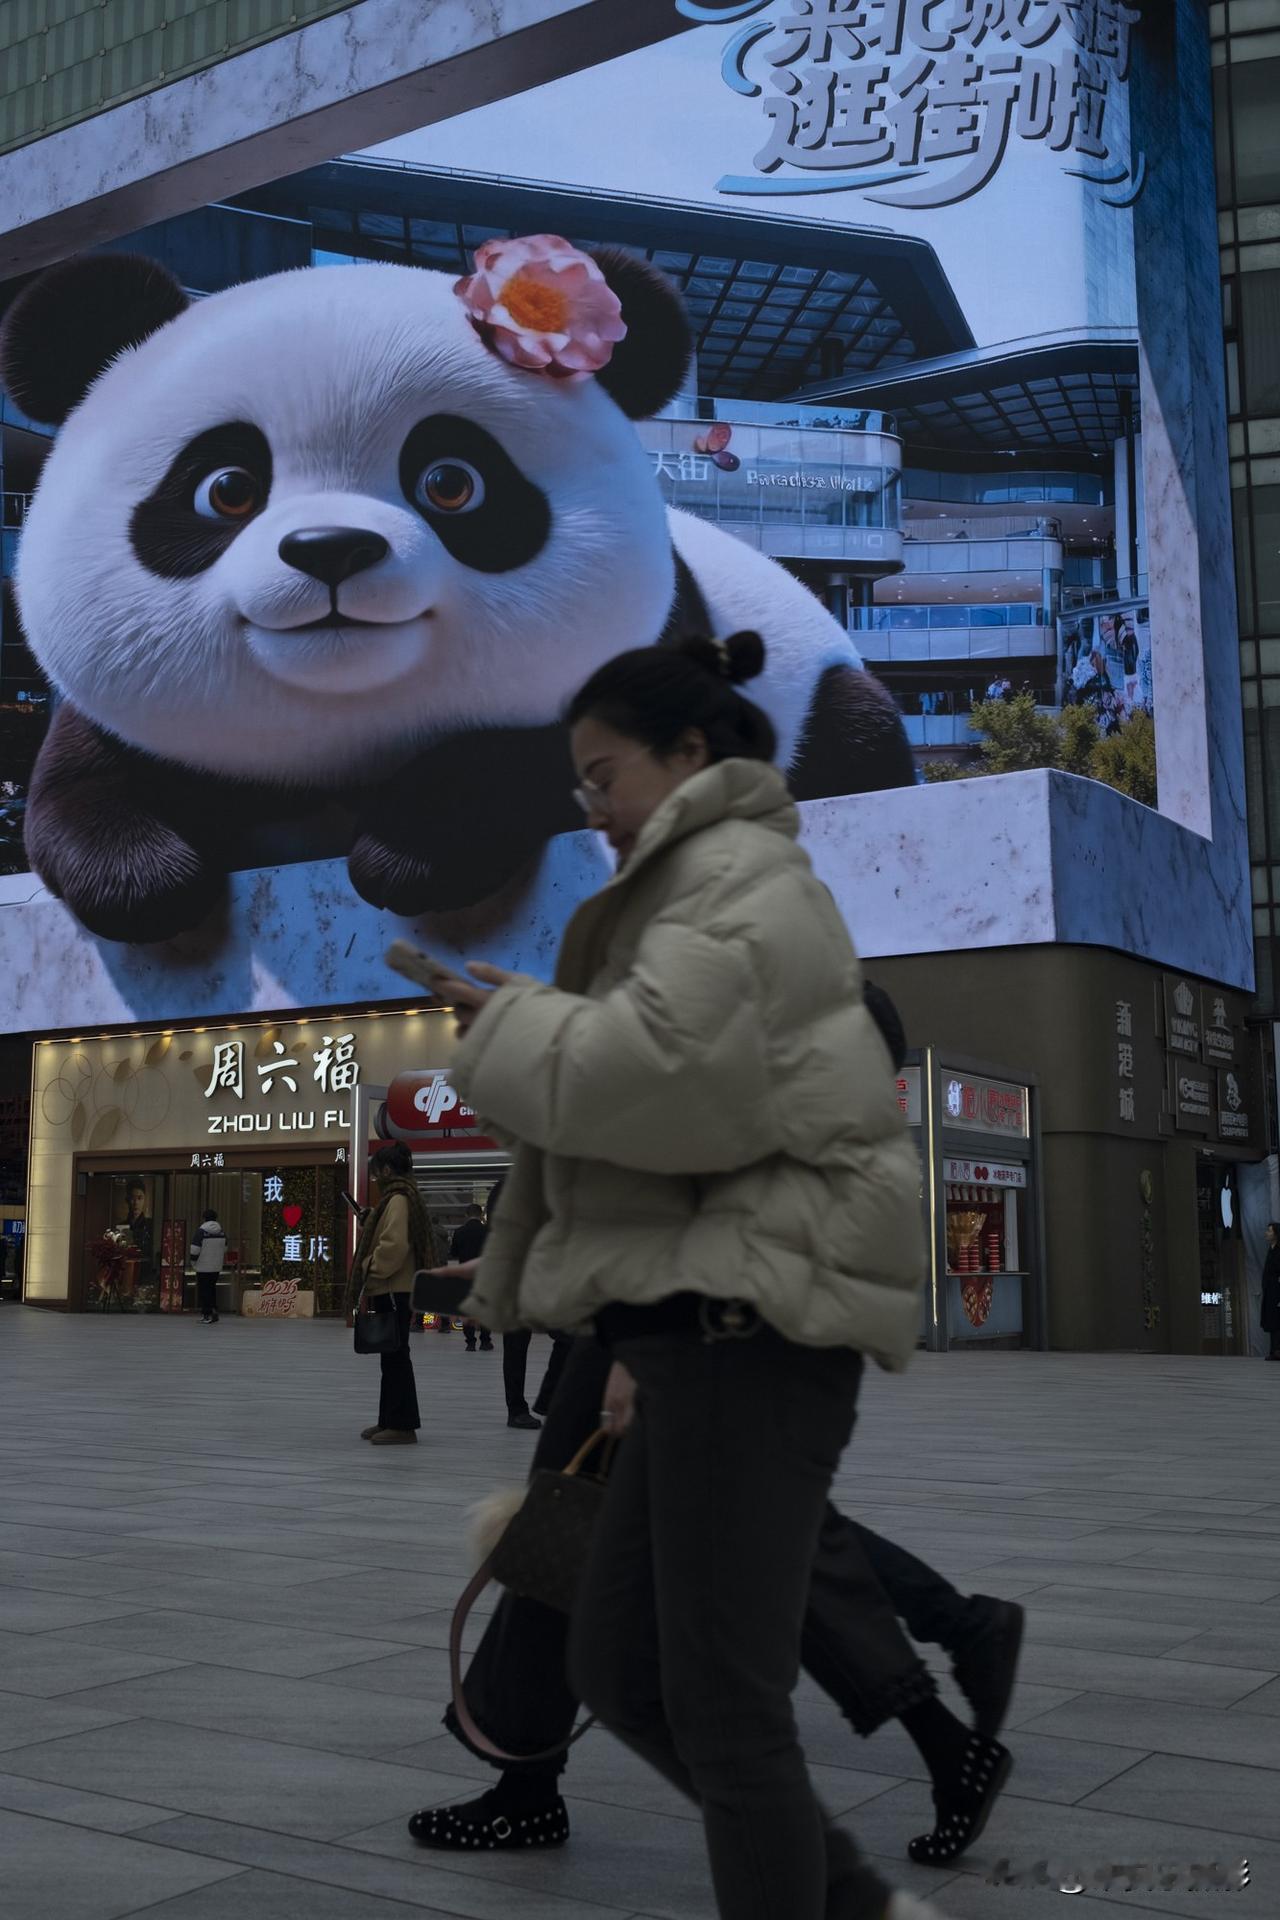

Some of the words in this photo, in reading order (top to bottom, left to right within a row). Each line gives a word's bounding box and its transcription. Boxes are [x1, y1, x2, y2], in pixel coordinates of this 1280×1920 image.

[753, 50, 1110, 210] 逛街啦
[746, 470, 829, 490] Paradise
[204, 1033, 360, 1100] 周六福
[1115, 999, 1135, 1122] 新港城
[207, 1112, 272, 1134] ZHOU
[279, 1110, 316, 1131] LIU
[190, 1152, 225, 1168] 周六福
[263, 1175, 284, 1202] 我
[281, 1234, 331, 1262] 重庆
[261, 1277, 301, 1296] 2026
[258, 1295, 297, 1313] 新年快乐
